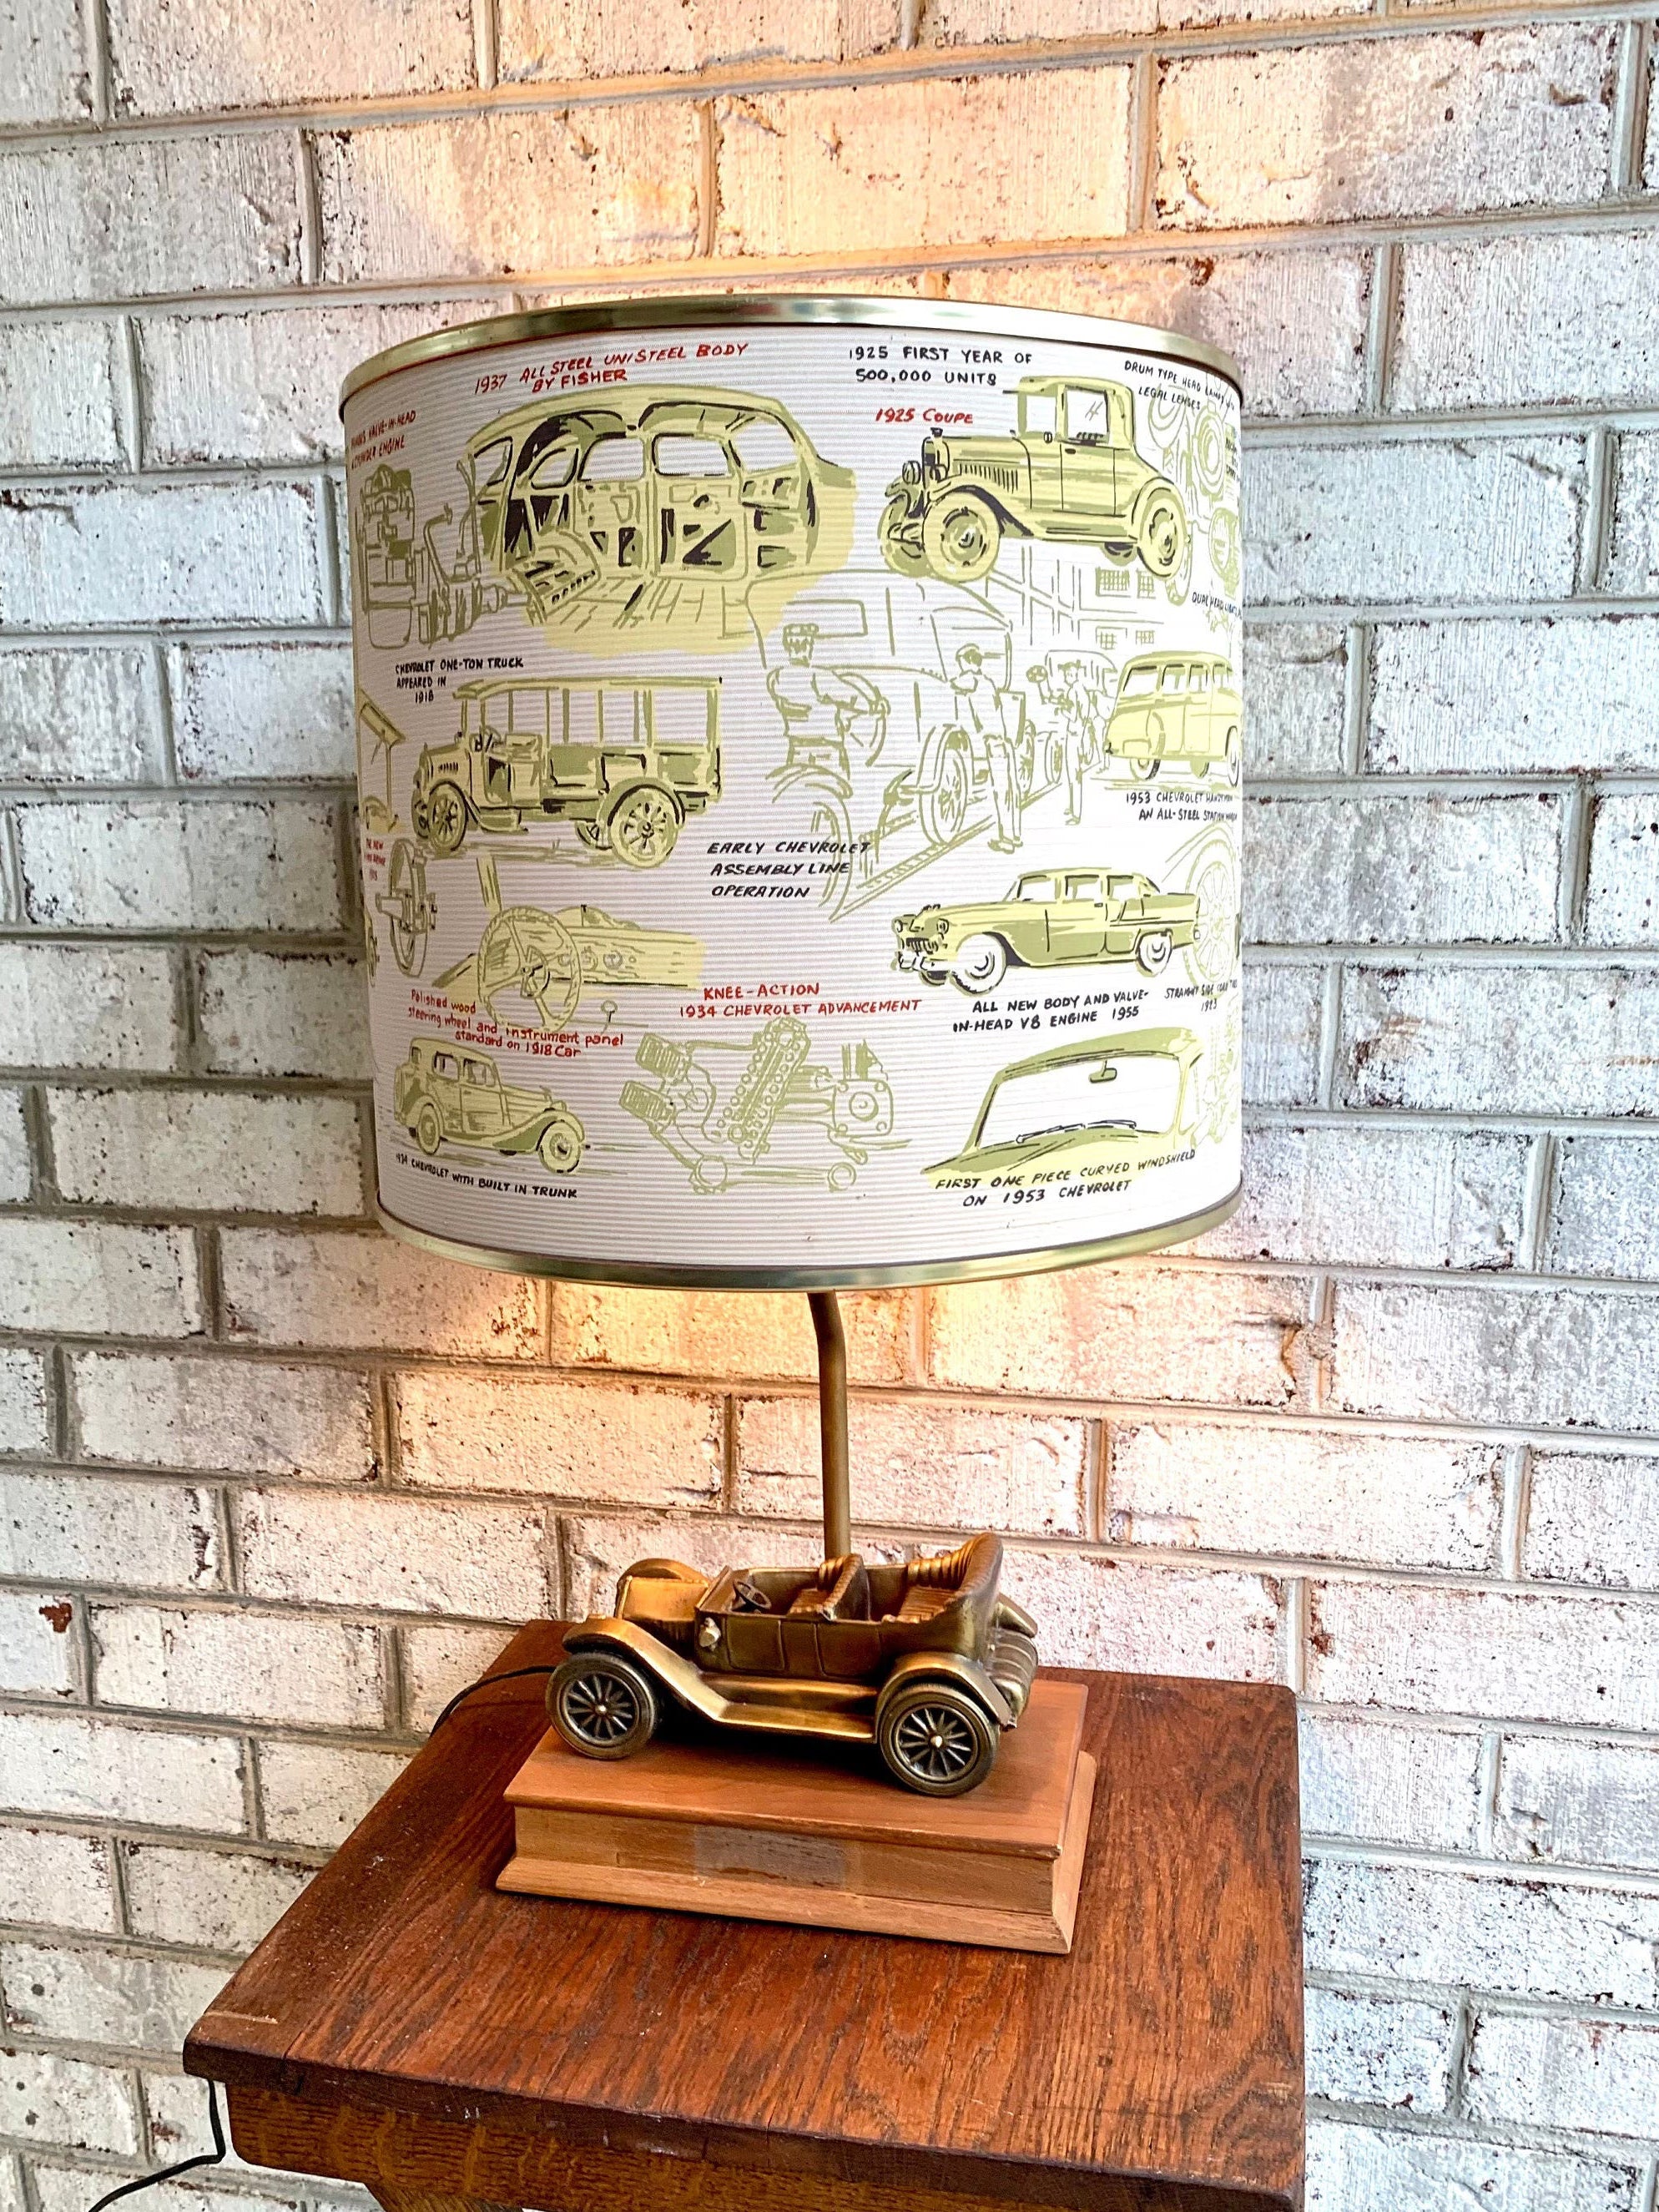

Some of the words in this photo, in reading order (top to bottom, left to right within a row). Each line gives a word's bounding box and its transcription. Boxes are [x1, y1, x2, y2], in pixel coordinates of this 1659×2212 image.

[849, 346, 889, 360] 1925
[903, 346, 950, 361] FIRST
[961, 349, 1003, 364] YEAR
[1014, 352, 1033, 364] OF
[474, 374, 507, 395] 1937
[519, 366, 545, 383] ALL
[551, 356, 593, 375] STEEL
[696, 342, 749, 358] BODY
[855, 367, 932, 383] 500,000
[945, 371, 996, 386] UNITS
[1124, 360, 1153, 377] DRUM
[1157, 368, 1177, 384] TYPE
[1182, 376, 1202, 392] HEAD
[532, 377, 556, 393] BY
[561, 369, 628, 389] FISHER
[1138, 386, 1167, 401] LEGAL
[1172, 393, 1201, 411] LENSES
[875, 407, 916, 423] 1925
[379, 435, 406, 457] ENGINE
[1193, 591, 1208, 607] DUAL
[395, 659, 436, 675] CHEVROLET
[440, 658, 484, 672] ONE-TON
[487, 656, 524, 669] TRUCK
[396, 676, 433, 689] APPEARED
[437, 676, 446, 687] IN
[1126, 791, 1151, 806] 1953
[1156, 791, 1203, 804] CHEVROLET
[1138, 807, 1153, 821] AN
[707, 842, 765, 855] EARLY
[775, 841, 871, 854] CHEVROLET
[710, 862, 804, 876] ASSEMBLY
[808, 862, 850, 874] LINE
[711, 885, 810, 898] OPERATION
[411, 989, 447, 1008] Polished
[451, 1002, 477, 1014] wood
[680, 1004, 717, 1018] 1934
[723, 1003, 813, 1017] CHEVROLET
[817, 999, 922, 1016] ADVANCEMENT
[972, 1001, 999, 1013] ALL
[1006, 1000, 1037, 1012] NEW
[1044, 995, 1081, 1010] BODY
[1084, 992, 1111, 1006] AND
[1113, 989, 1150, 1002] VALVE-
[408, 1006, 441, 1028] steering
[445, 1013, 471, 1029] wheel
[477, 1022, 497, 1034] and
[506, 1028, 580, 1044] instrument
[585, 1033, 624, 1048] panel
[952, 1018, 1013, 1033] IN-HEAD
[1021, 1014, 1041, 1030] V8
[1050, 1011, 1098, 1028] ENGINE
[1112, 1006, 1140, 1021] 1955
[455, 1030, 503, 1048] standard
[507, 1041, 521, 1051] on
[526, 1041, 552, 1056] 1918
[555, 1044, 582, 1058] Car
[411, 1158, 449, 1179] CHEVROLET
[452, 1173, 474, 1185] WITH
[478, 1178, 511, 1192] BUILT
[514, 1184, 527, 1195] IN
[532, 1185, 578, 1199] TRUNK
[935, 1178, 982, 1189] FIRST
[991, 1174, 1026, 1188] ONE
[1032, 1169, 1072, 1184] PIECE
[1080, 1163, 1131, 1177] CURVED
[1137, 1149, 1196, 1170] WINDSHIELD
[963, 1194, 988, 1207] ON
[1002, 1189, 1046, 1204] 1953
[1058, 1179, 1132, 1198] CHEVROLET
